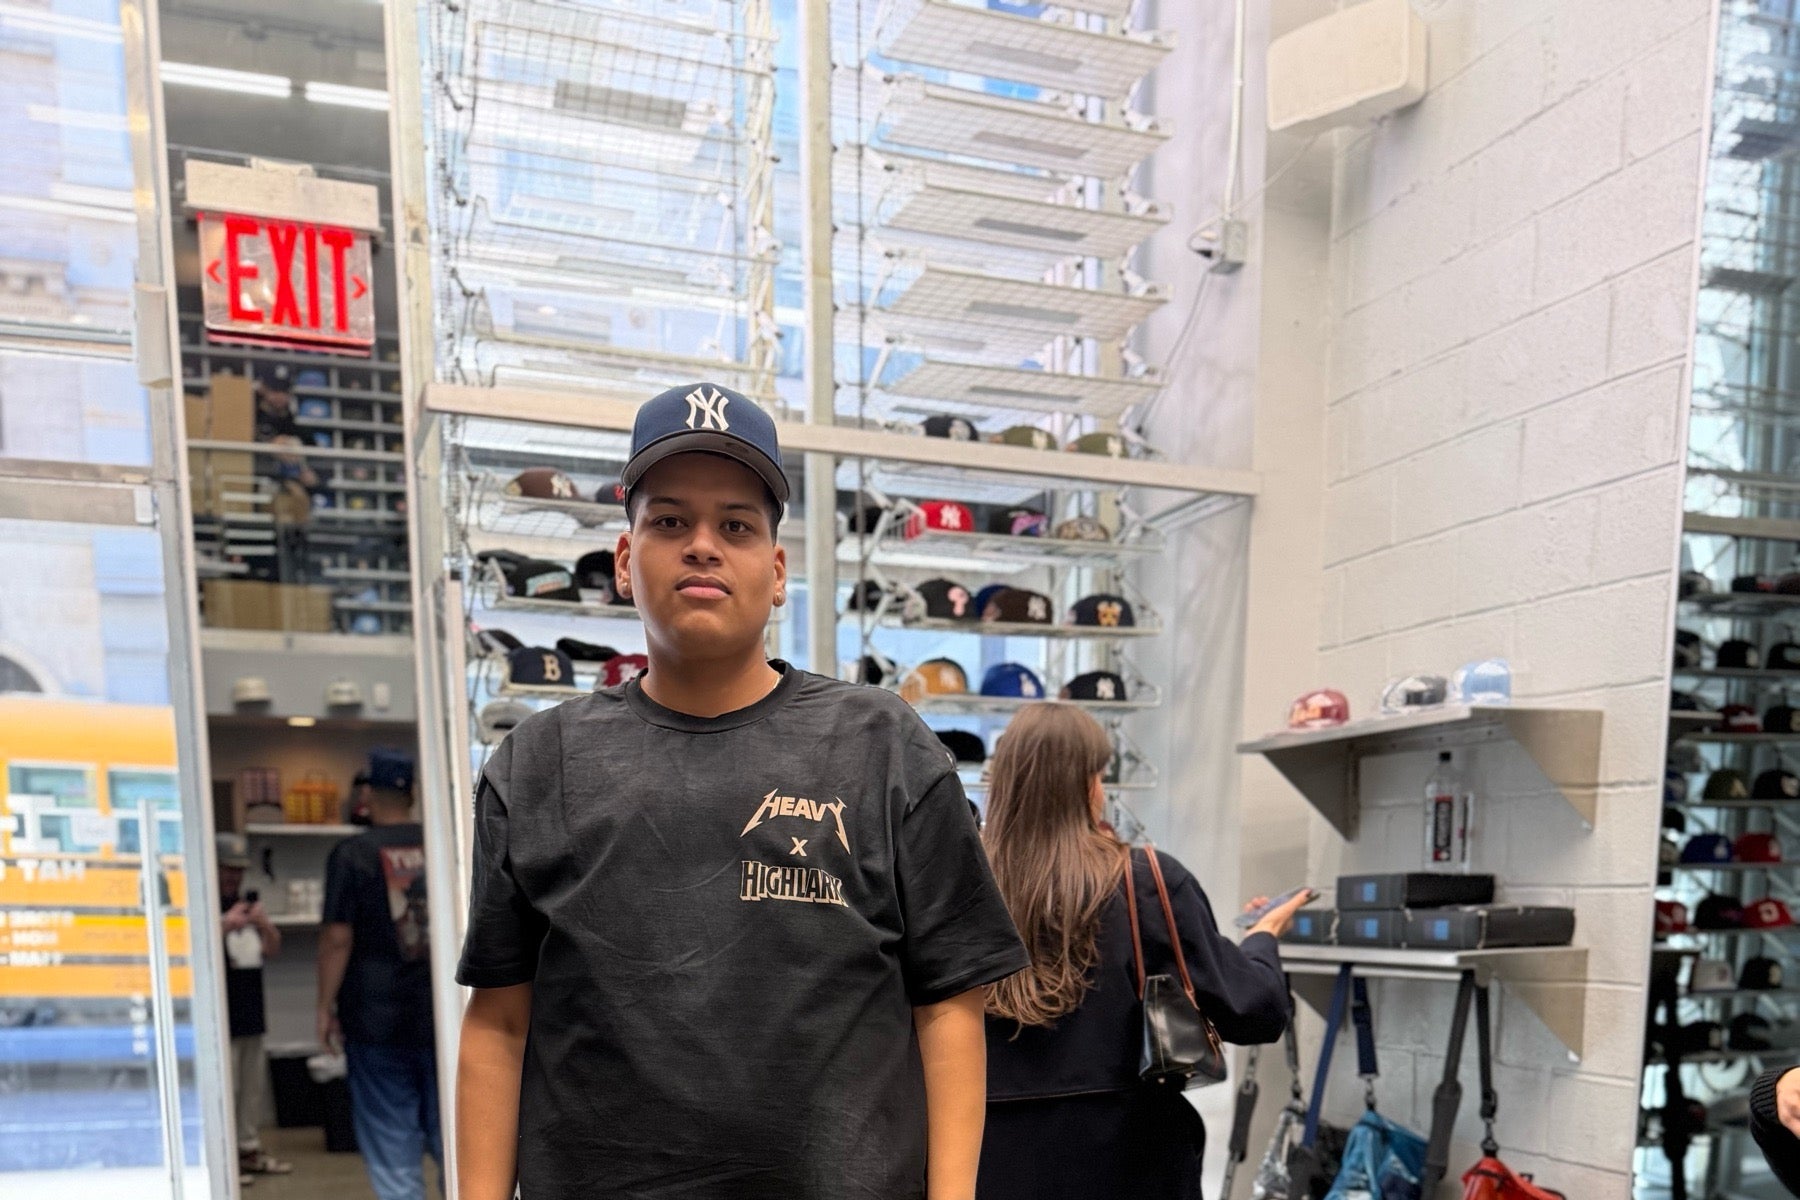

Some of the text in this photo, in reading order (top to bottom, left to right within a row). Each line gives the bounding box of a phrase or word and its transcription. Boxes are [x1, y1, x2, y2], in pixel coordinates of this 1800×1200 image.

[224, 213, 354, 334] EXIT
[685, 387, 730, 431] NY
[542, 654, 561, 681] B
[740, 787, 851, 855] HEAVY
